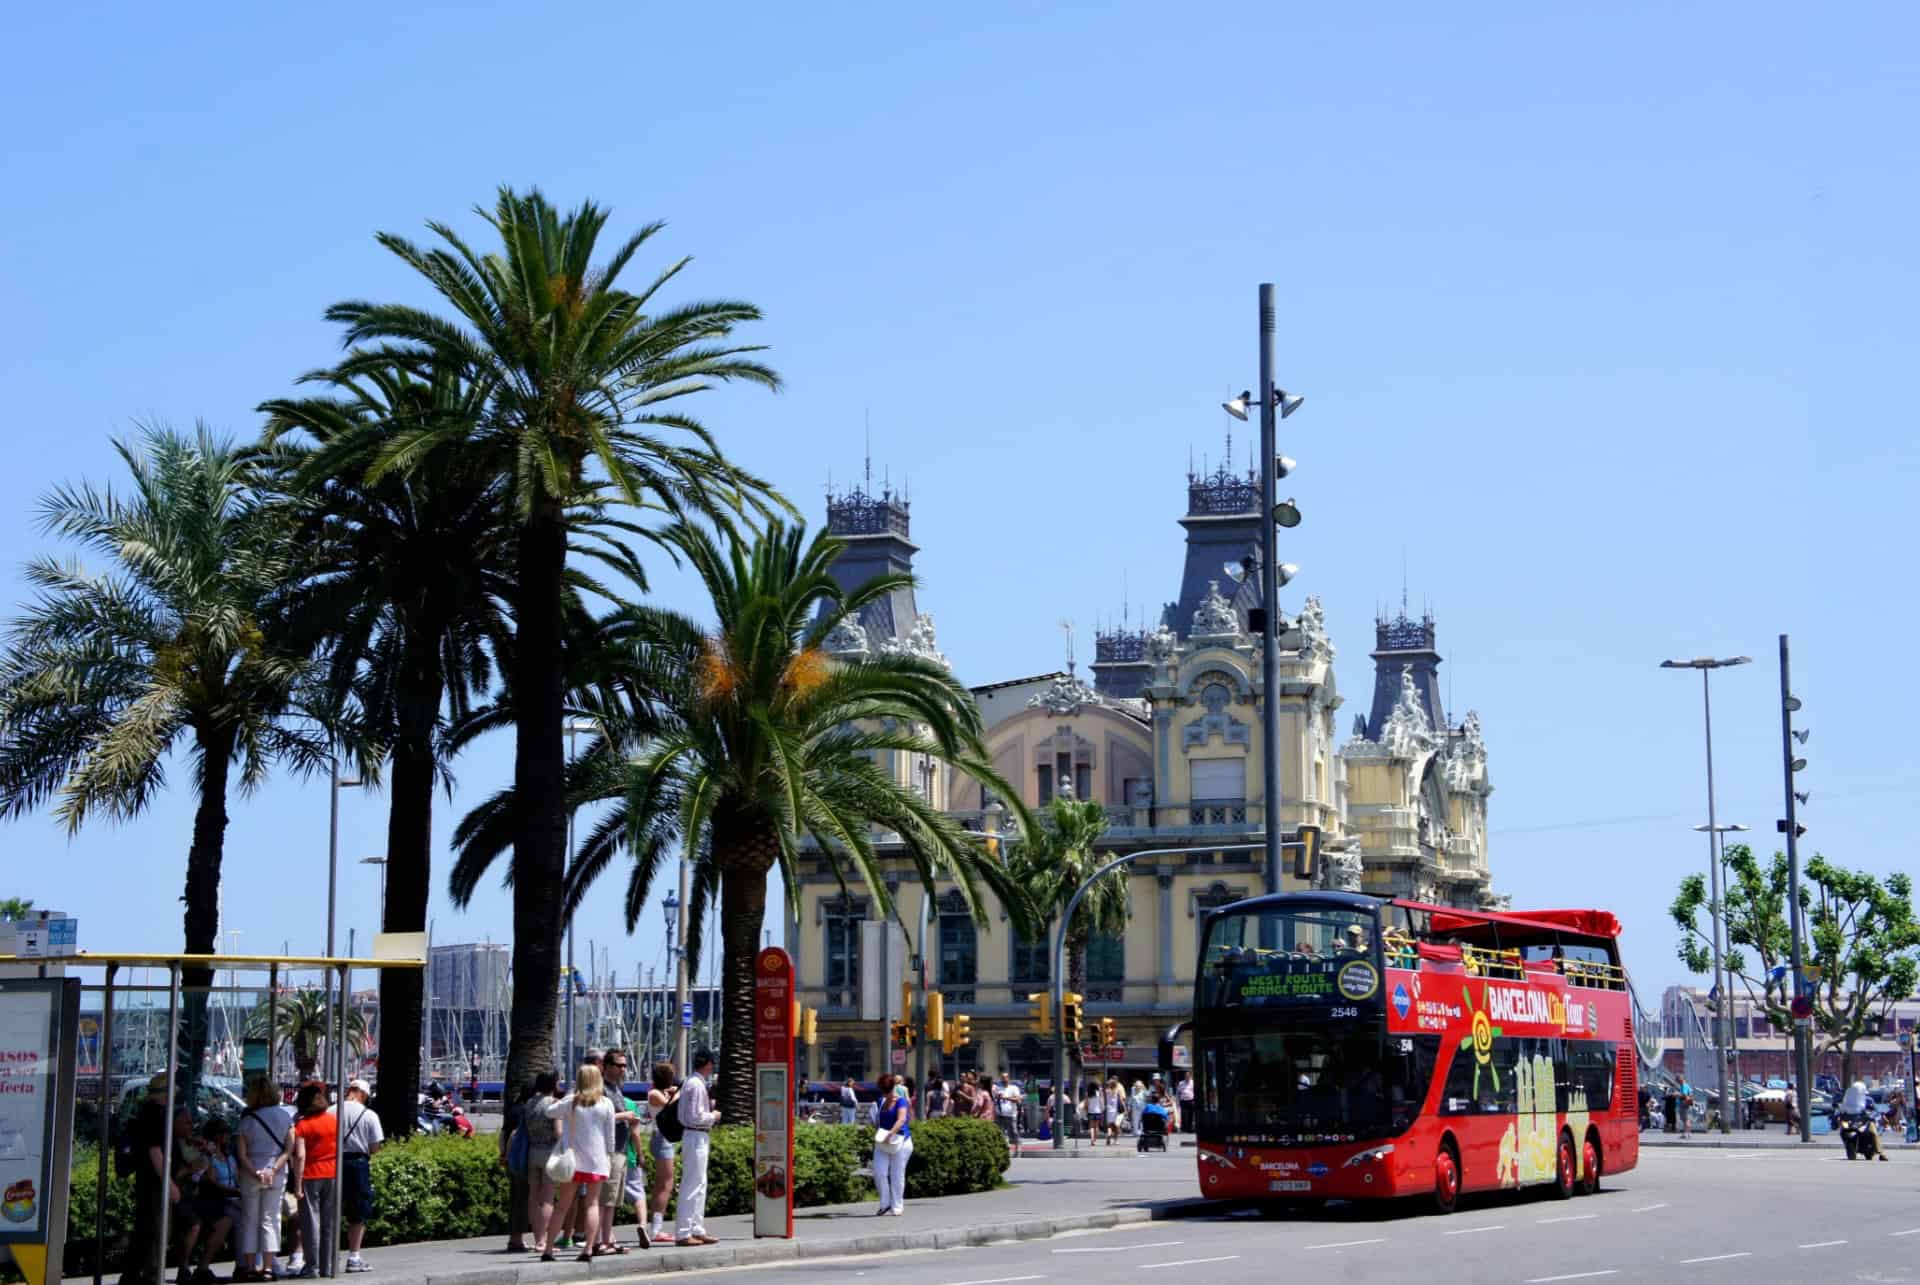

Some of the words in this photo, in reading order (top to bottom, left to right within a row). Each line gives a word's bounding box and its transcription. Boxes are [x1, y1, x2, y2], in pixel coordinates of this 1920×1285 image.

[1248, 976, 1280, 985] WEST
[1285, 974, 1326, 985] ROUTE
[1241, 985, 1288, 996] ORANGE
[1292, 983, 1334, 994] ROUTE
[1488, 986, 1549, 1024] BARCELONA
[1331, 1007, 1358, 1017] 2546
